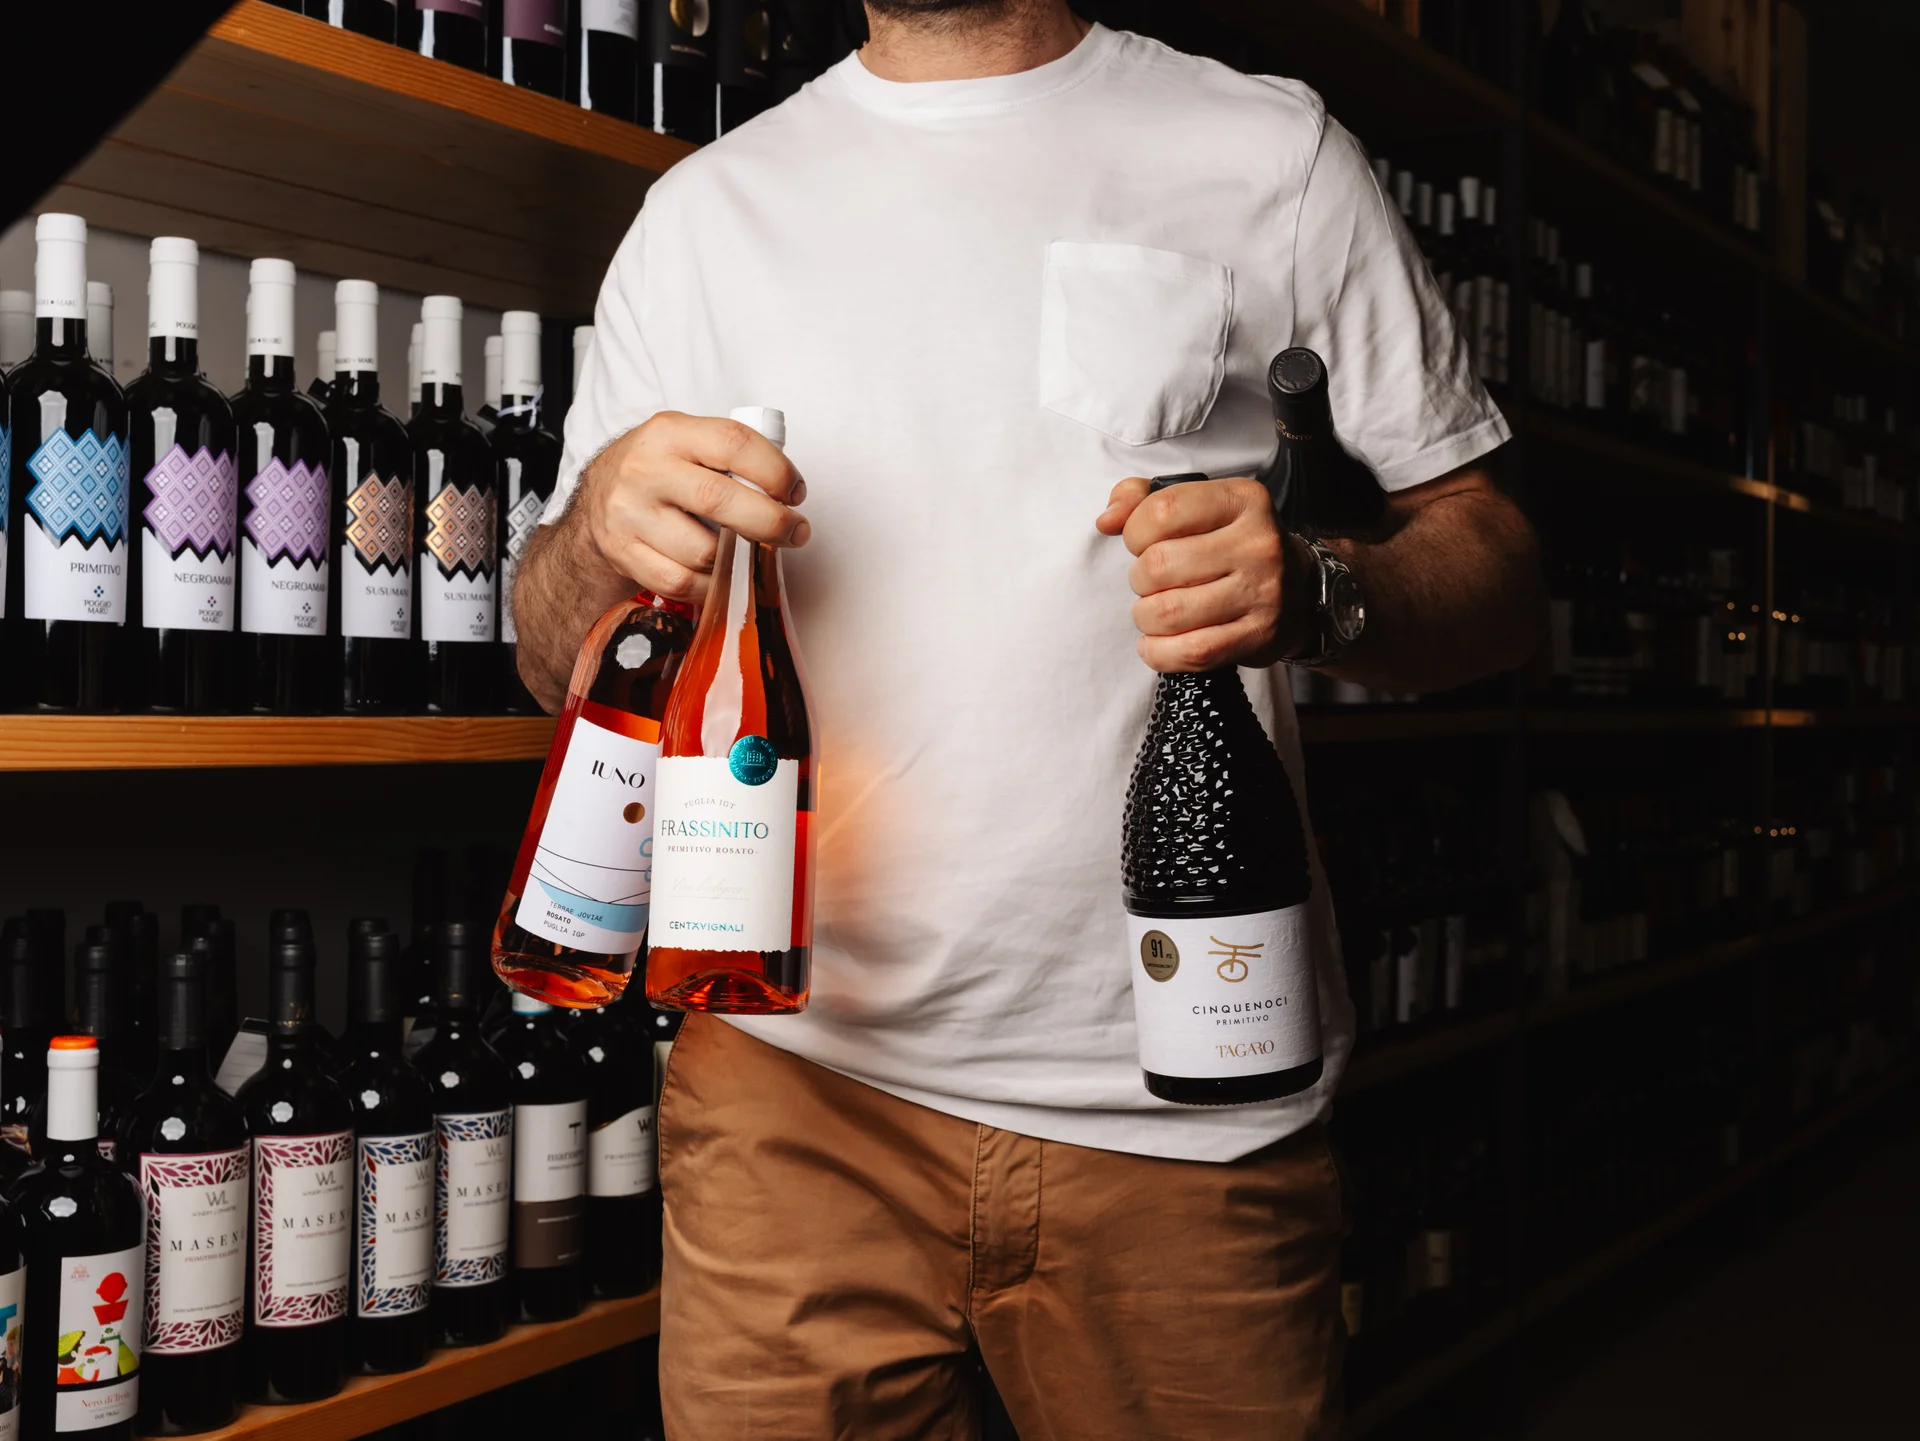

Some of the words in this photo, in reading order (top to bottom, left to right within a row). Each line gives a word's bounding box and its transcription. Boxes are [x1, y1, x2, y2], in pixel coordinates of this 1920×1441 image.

[70, 562, 121, 576] PRIMITIVO
[84, 599, 111, 608] POGGIO
[591, 760, 645, 789] IUNO
[684, 797, 716, 808] PUGLIA
[719, 799, 736, 810] IGT
[661, 819, 769, 839] FRASSINITO
[667, 845, 711, 853] PRIMITIVO
[715, 847, 754, 855] ROSATO
[546, 910, 571, 925] ROSATO
[549, 901, 574, 915] TERRAE
[577, 909, 603, 922] JOVIAE
[543, 920, 568, 935] PUGLIA
[572, 928, 586, 938] IGP
[1150, 938, 1164, 959] 91
[1192, 996, 1288, 1015] CINQUENOCI
[1216, 1014, 1269, 1026] PRIMITIVO
[1215, 1040, 1275, 1058] TAGARO
[82, 1399, 104, 1408] Nero
[105, 1395, 113, 1404] di
